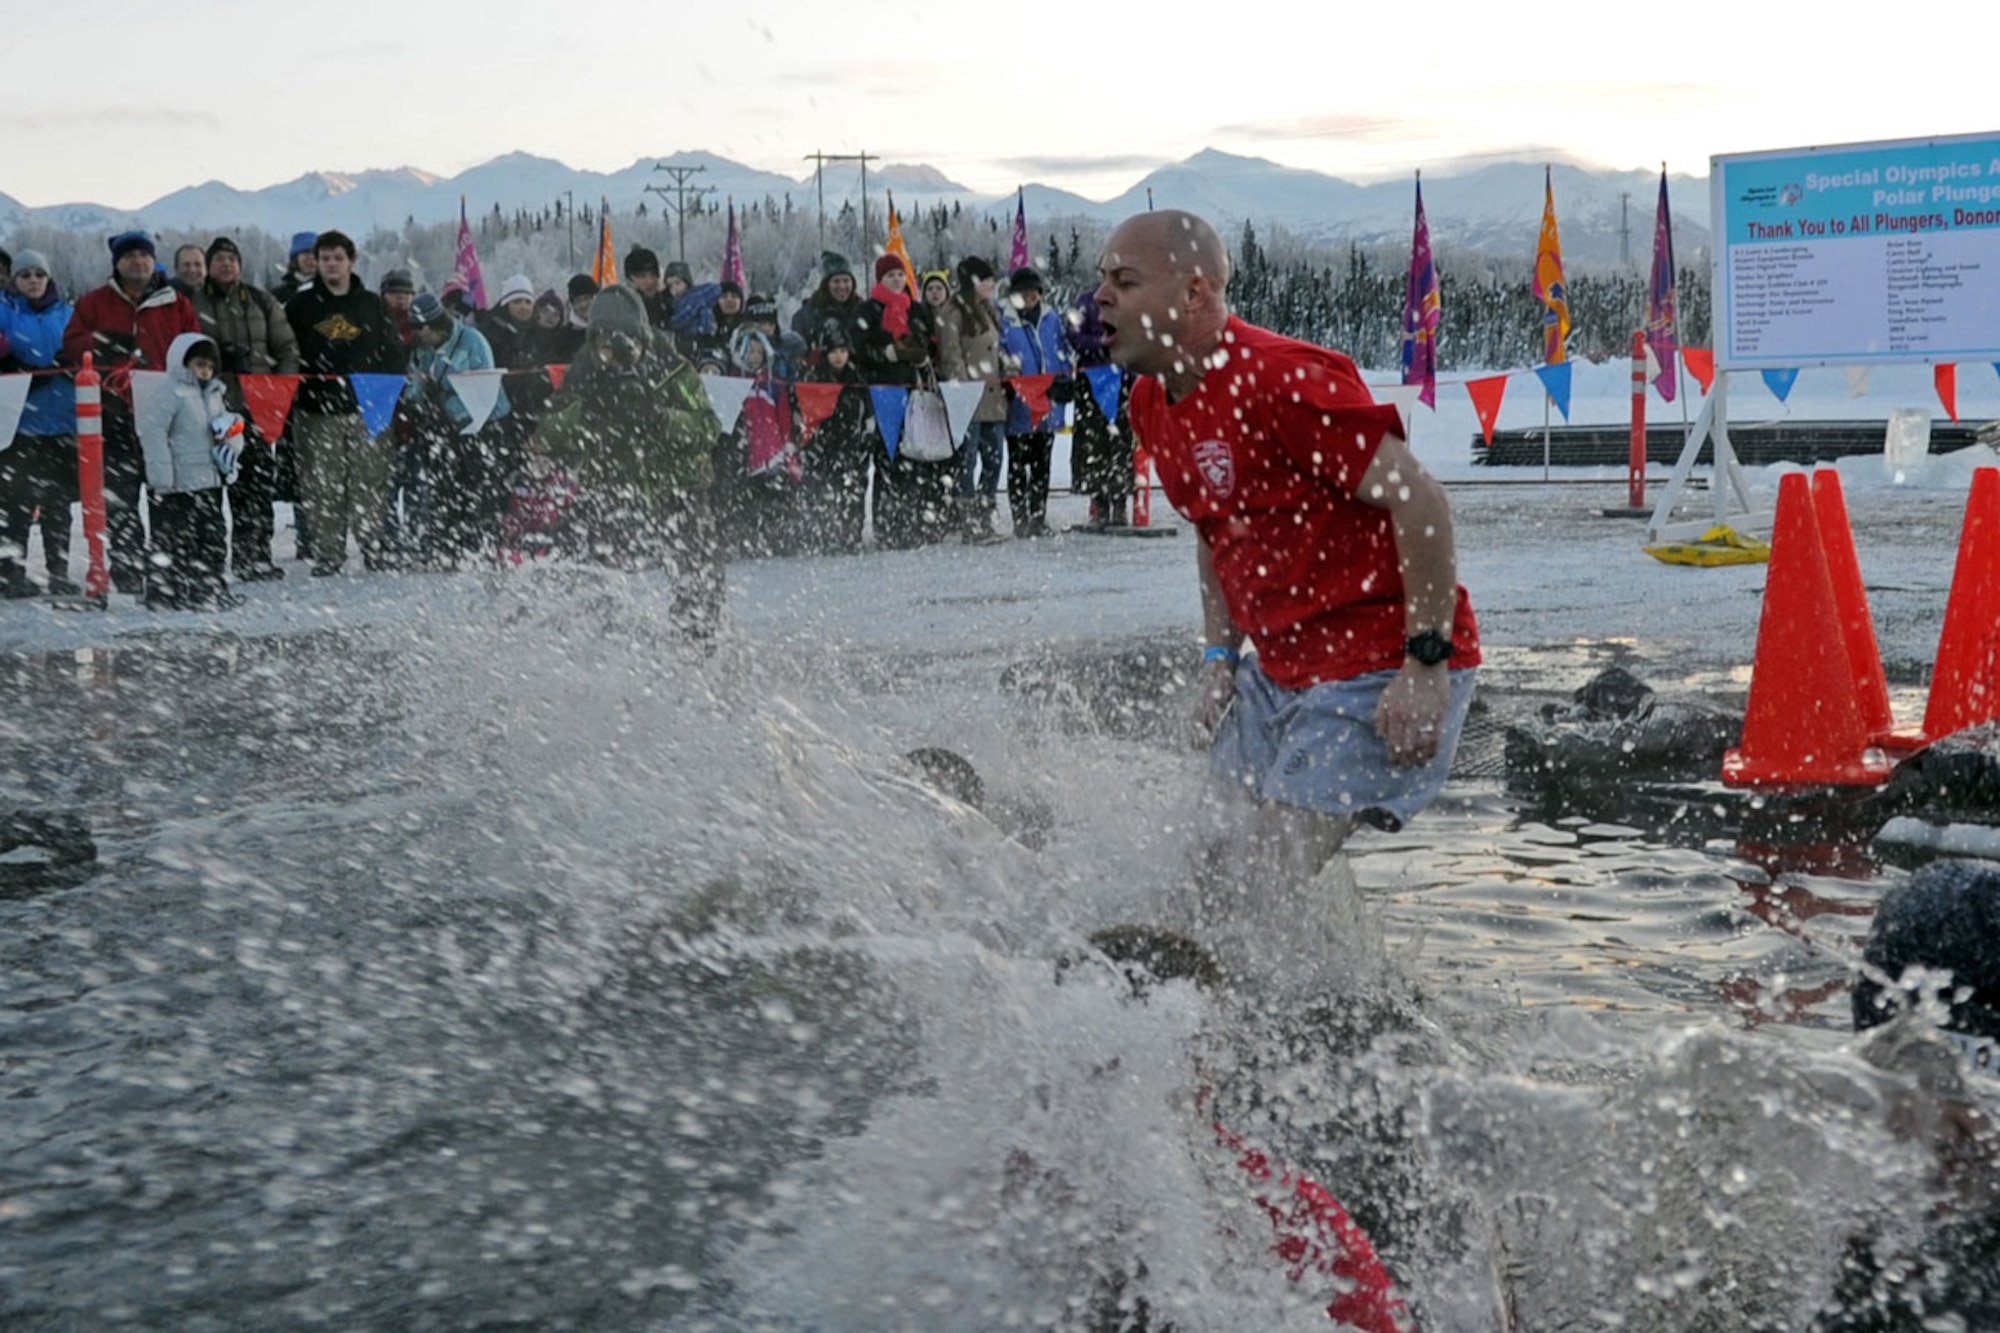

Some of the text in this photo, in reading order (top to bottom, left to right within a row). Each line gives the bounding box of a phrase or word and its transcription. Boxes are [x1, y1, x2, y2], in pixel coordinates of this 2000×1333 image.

[1806, 168, 1879, 192] Special
[1885, 161, 1981, 184] Olympics
[1873, 188, 1926, 206] Polar
[1748, 219, 1793, 239] Thank
[1798, 218, 1825, 235] You
[1831, 218, 1845, 233] to
[1851, 213, 1869, 232] All
[1875, 213, 1948, 233] Plungers,
